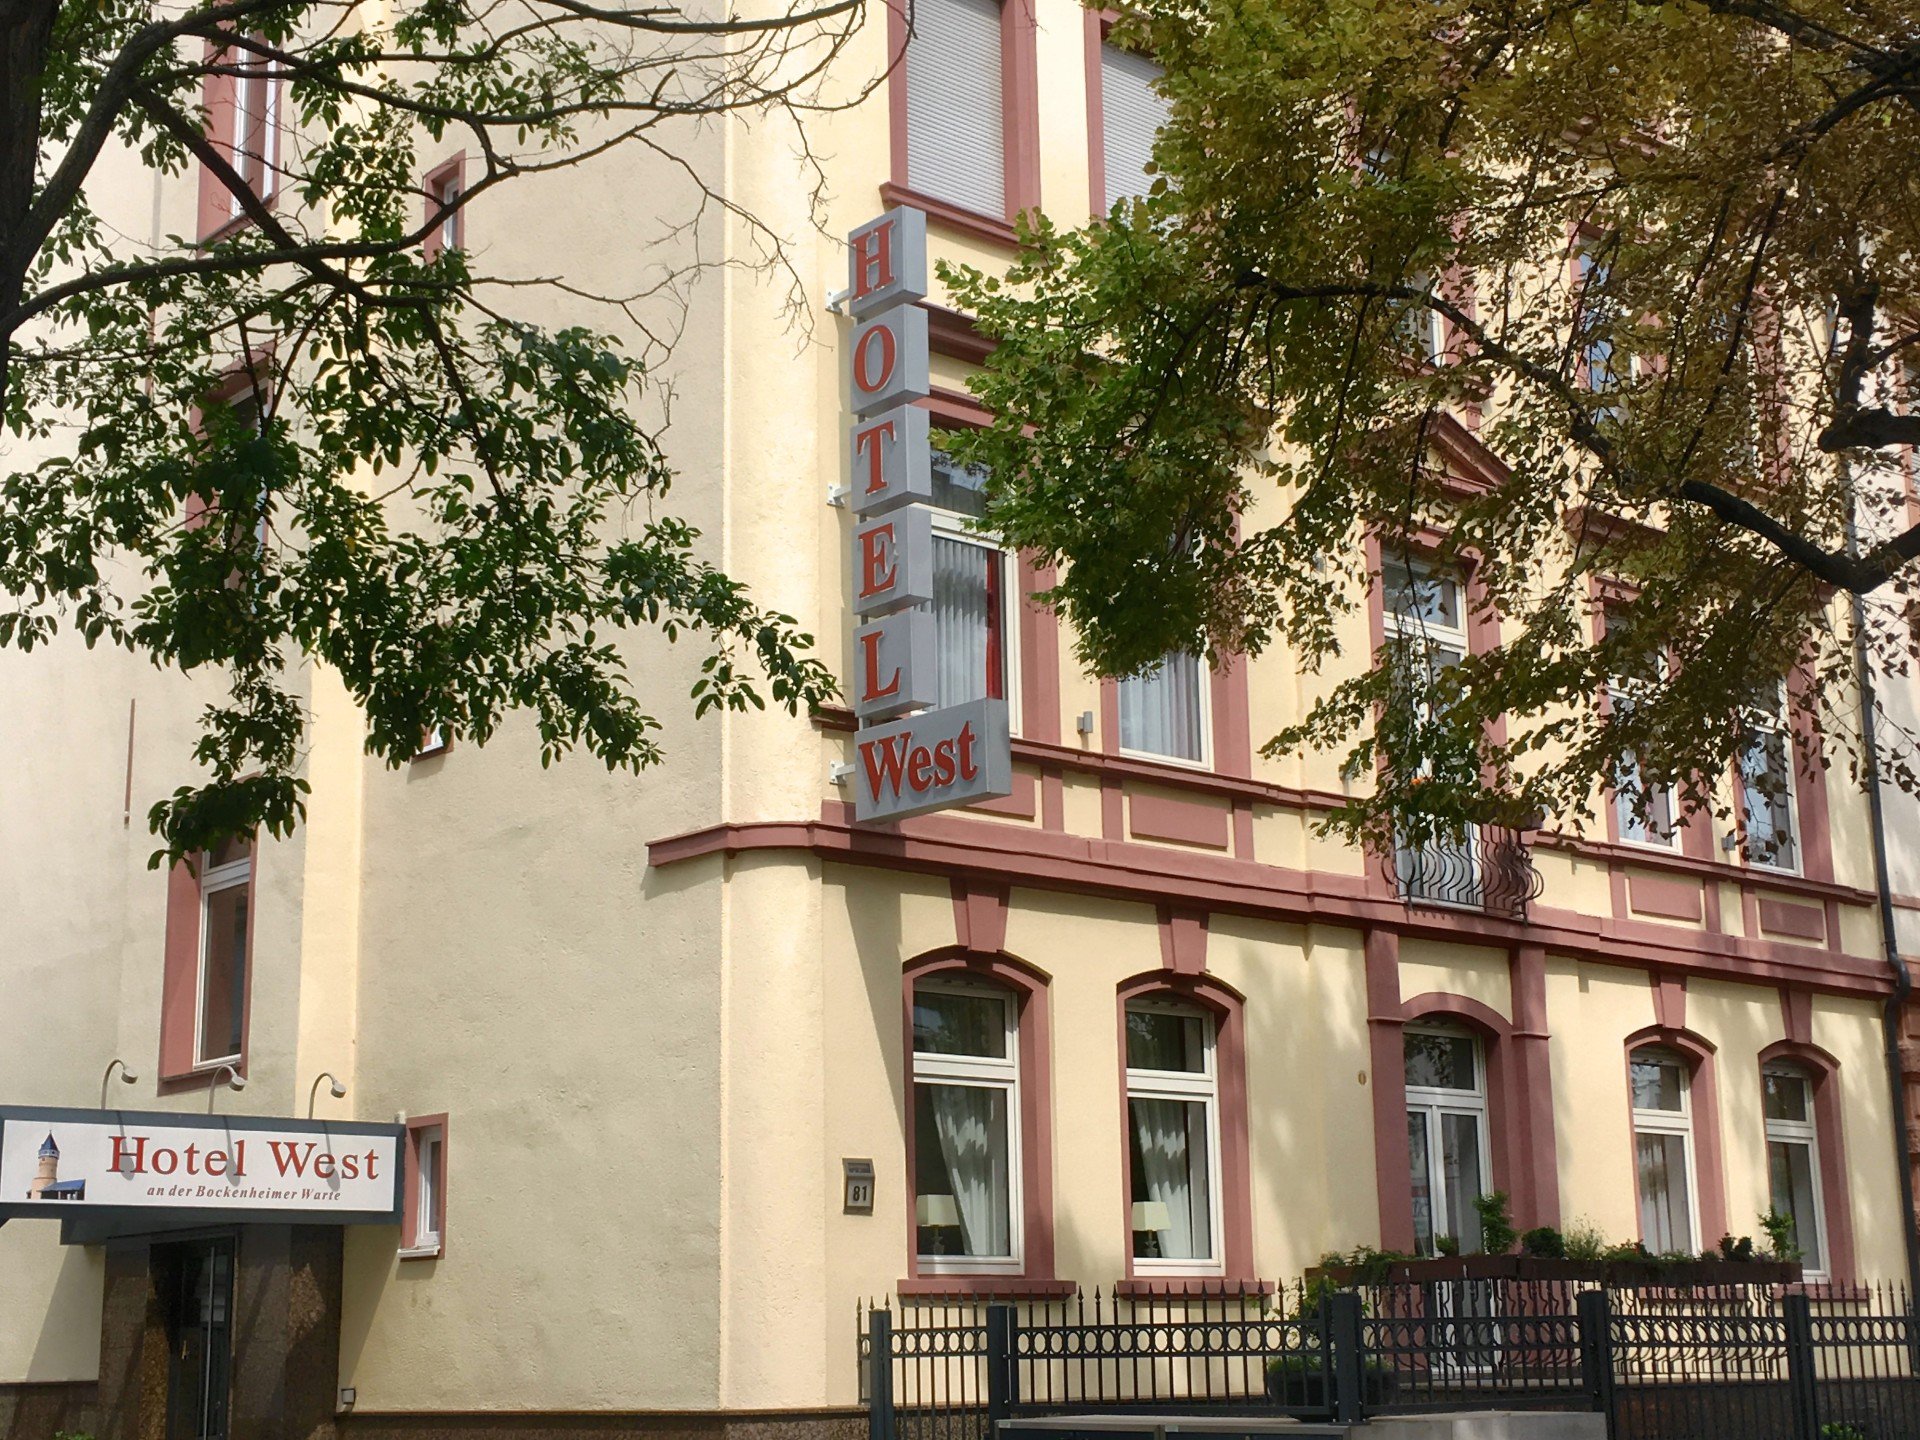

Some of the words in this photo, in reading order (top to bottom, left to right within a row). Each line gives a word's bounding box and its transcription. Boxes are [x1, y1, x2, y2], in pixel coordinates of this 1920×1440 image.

[851, 219, 900, 702] HOTEL
[858, 720, 978, 803] West
[106, 1135, 248, 1178] Hotel
[266, 1140, 380, 1180] West
[147, 1186, 165, 1197] an
[168, 1184, 193, 1198] der
[195, 1185, 298, 1200] Bockenheimer
[301, 1188, 341, 1201] Warte
[852, 1185, 868, 1202] 81
